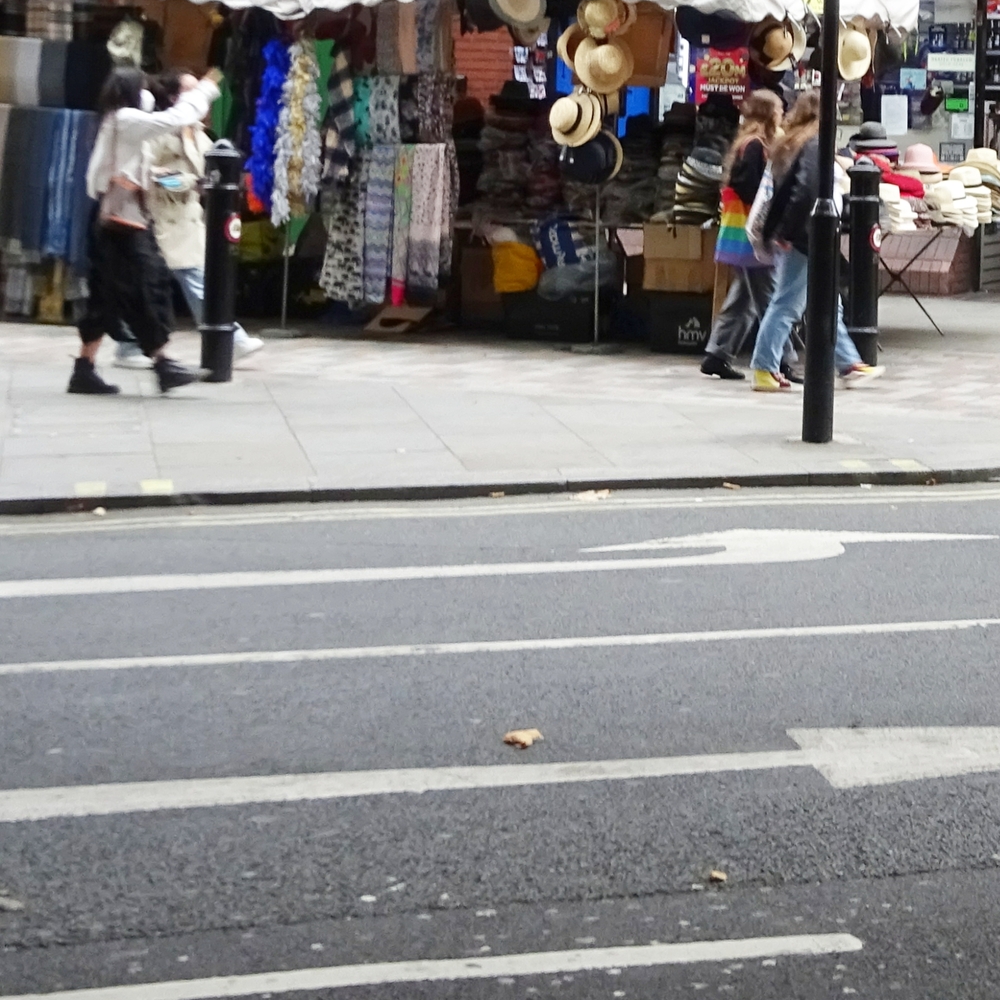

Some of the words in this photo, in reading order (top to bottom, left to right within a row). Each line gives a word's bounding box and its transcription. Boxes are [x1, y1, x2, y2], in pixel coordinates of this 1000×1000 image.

[700, 57, 746, 78] £20M
[729, 85, 745, 93] WON
[678, 325, 707, 341] hmv
